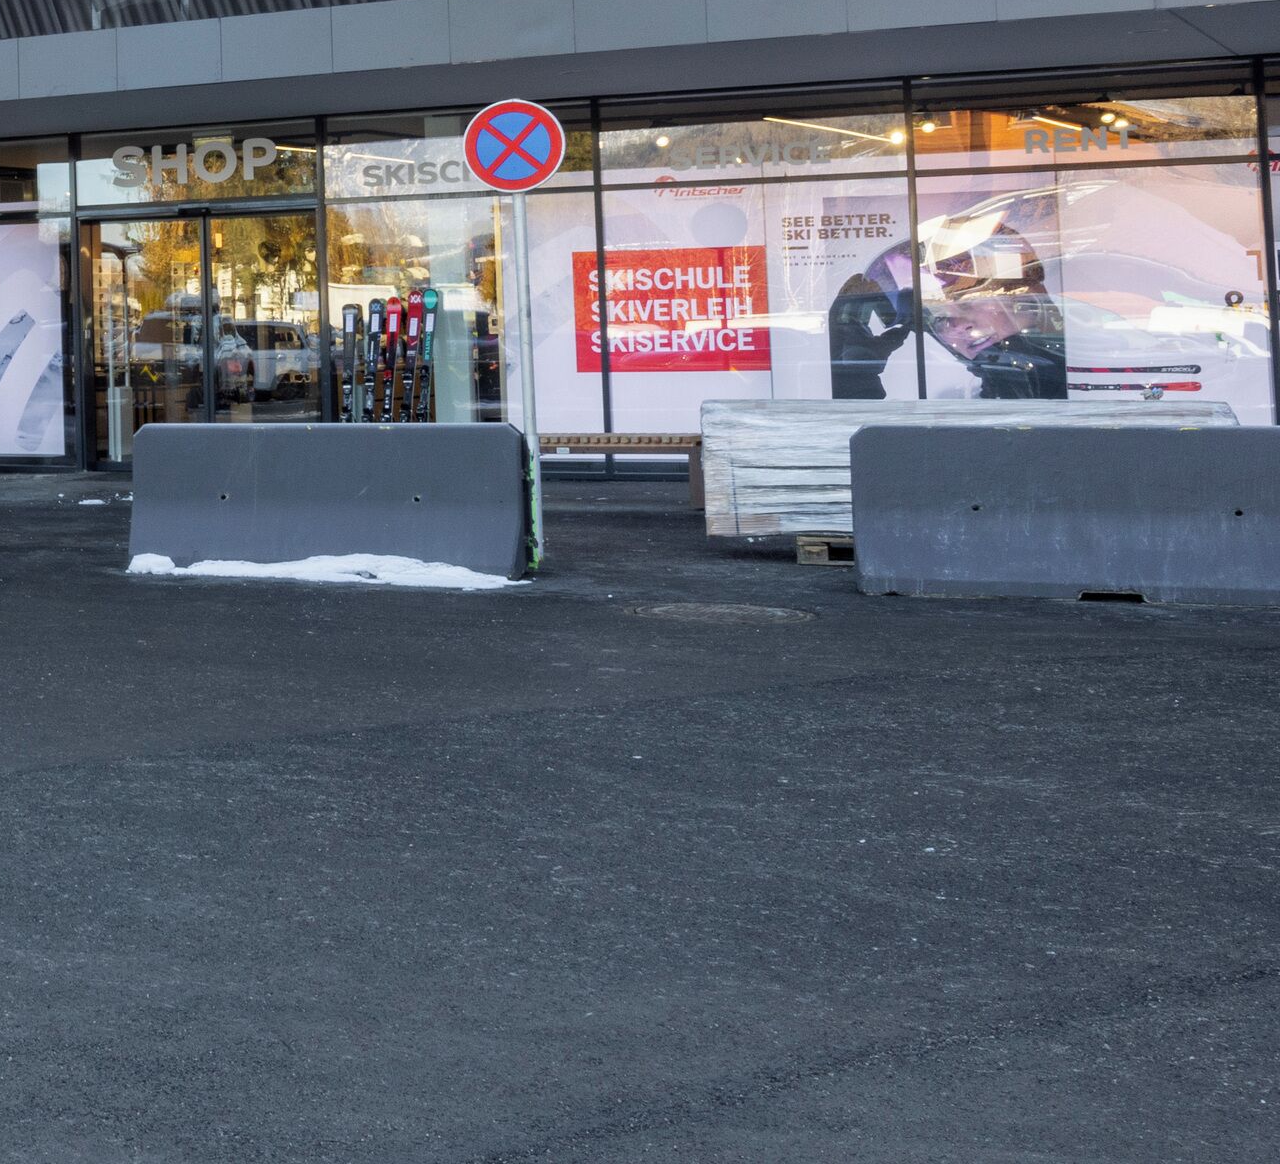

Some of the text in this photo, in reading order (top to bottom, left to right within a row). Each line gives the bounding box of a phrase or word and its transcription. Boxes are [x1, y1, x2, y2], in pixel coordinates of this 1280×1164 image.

[1024, 124, 1138, 154] RENT
[111, 137, 278, 187] SHOP
[669, 141, 832, 172] SERVICE
[362, 159, 471, 187] SKISC
[781, 213, 897, 228] SEE BETTER.
[782, 226, 893, 241] SKI BETTER.
[588, 265, 753, 292] SKISCHULE
[590, 295, 753, 323] SKIVERLEIH
[590, 327, 756, 354] SKISERVICE
